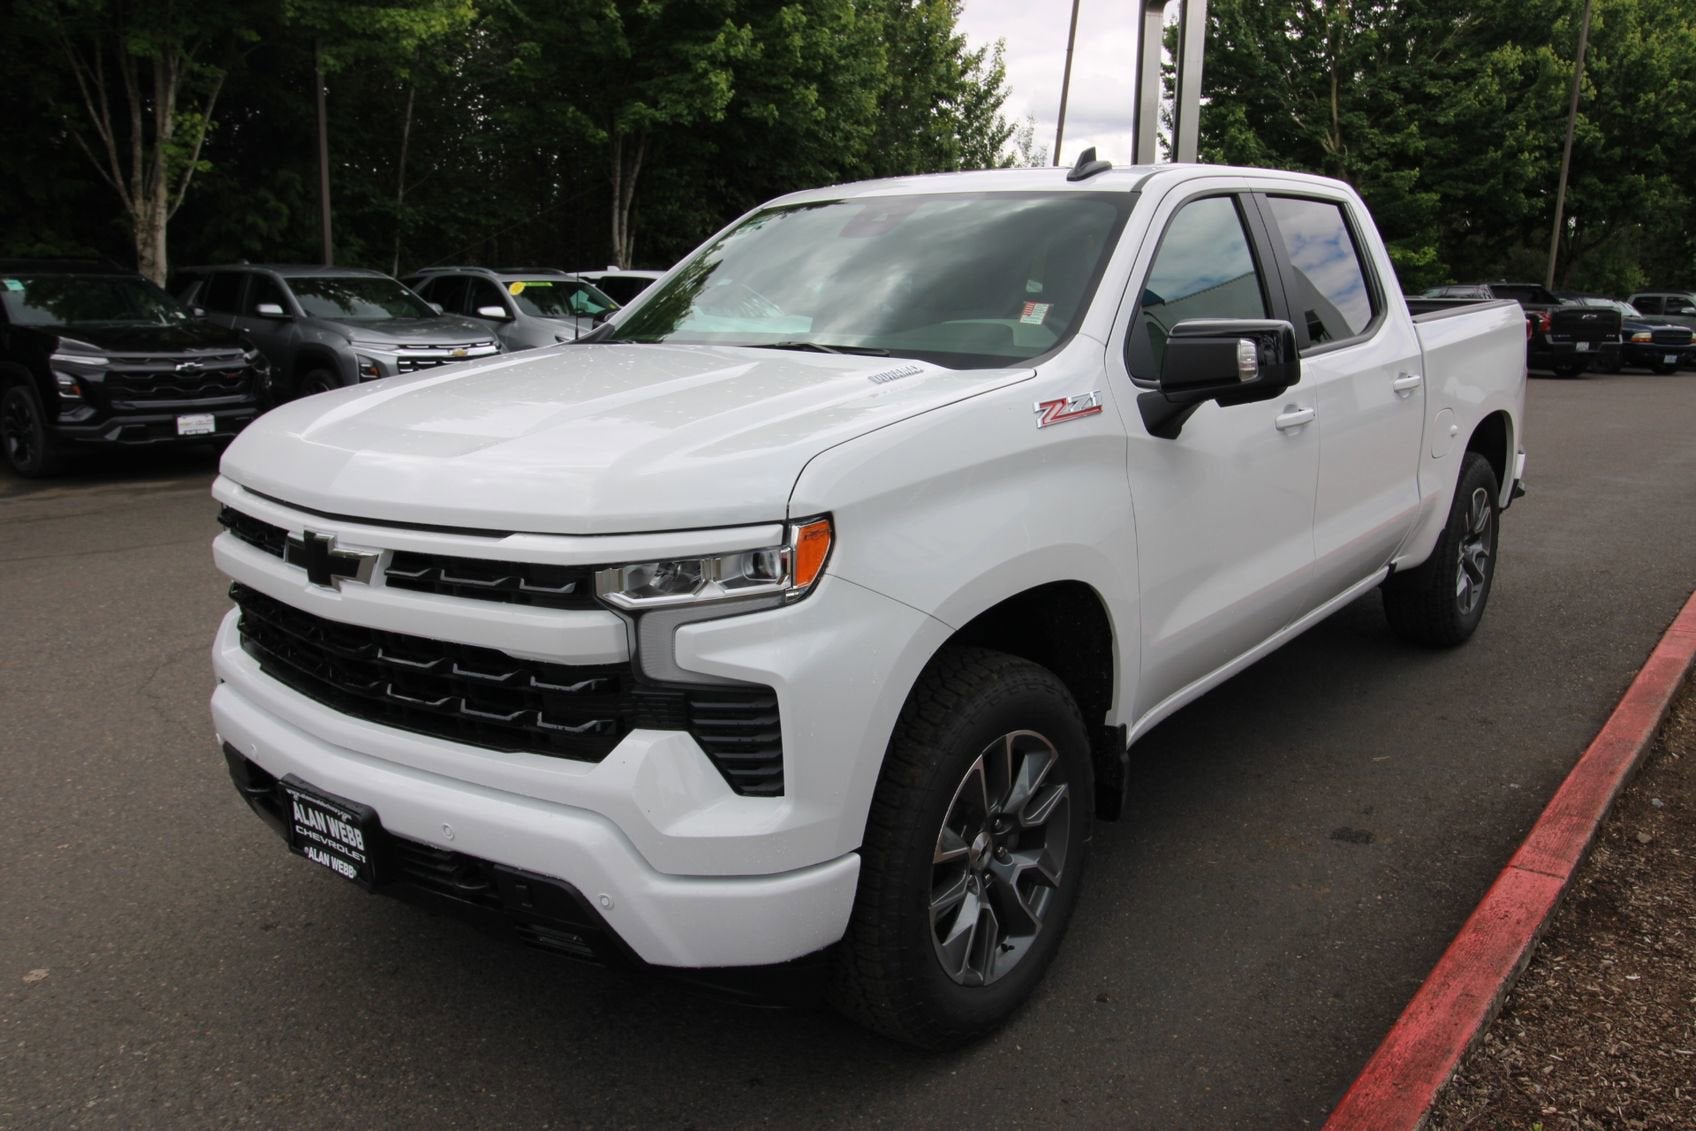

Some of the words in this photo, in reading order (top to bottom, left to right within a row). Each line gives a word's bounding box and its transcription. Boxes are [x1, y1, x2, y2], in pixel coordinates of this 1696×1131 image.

[293, 801, 327, 834] ALAN
[326, 815, 364, 851] WEBB
[296, 825, 366, 863] CHEVROLET
[308, 846, 330, 867] ALAN
[331, 856, 354, 879] WEBB
